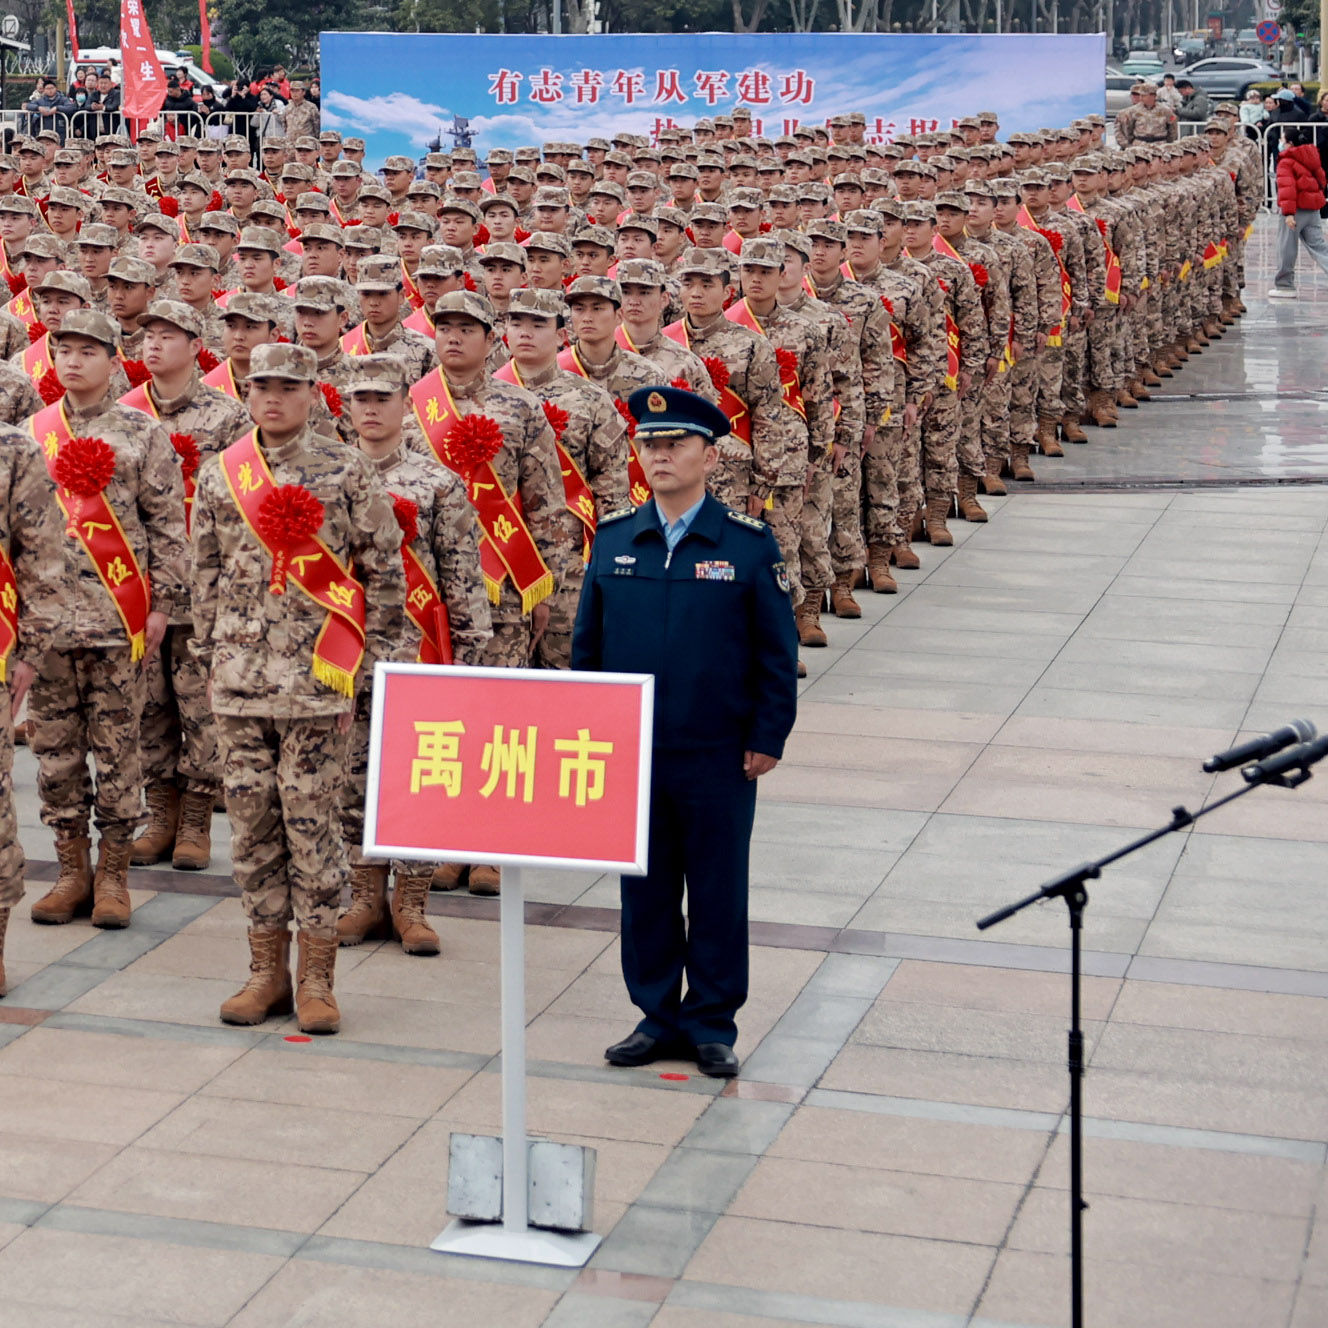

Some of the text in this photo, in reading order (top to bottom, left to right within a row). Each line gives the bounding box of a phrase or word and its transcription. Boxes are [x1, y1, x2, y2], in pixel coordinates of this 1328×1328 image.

[487, 68, 816, 105] 有志青年从军建功
[426, 396, 519, 544] 光入伍
[238, 461, 356, 609] 光入伍
[410, 720, 614, 807] 禹州市
